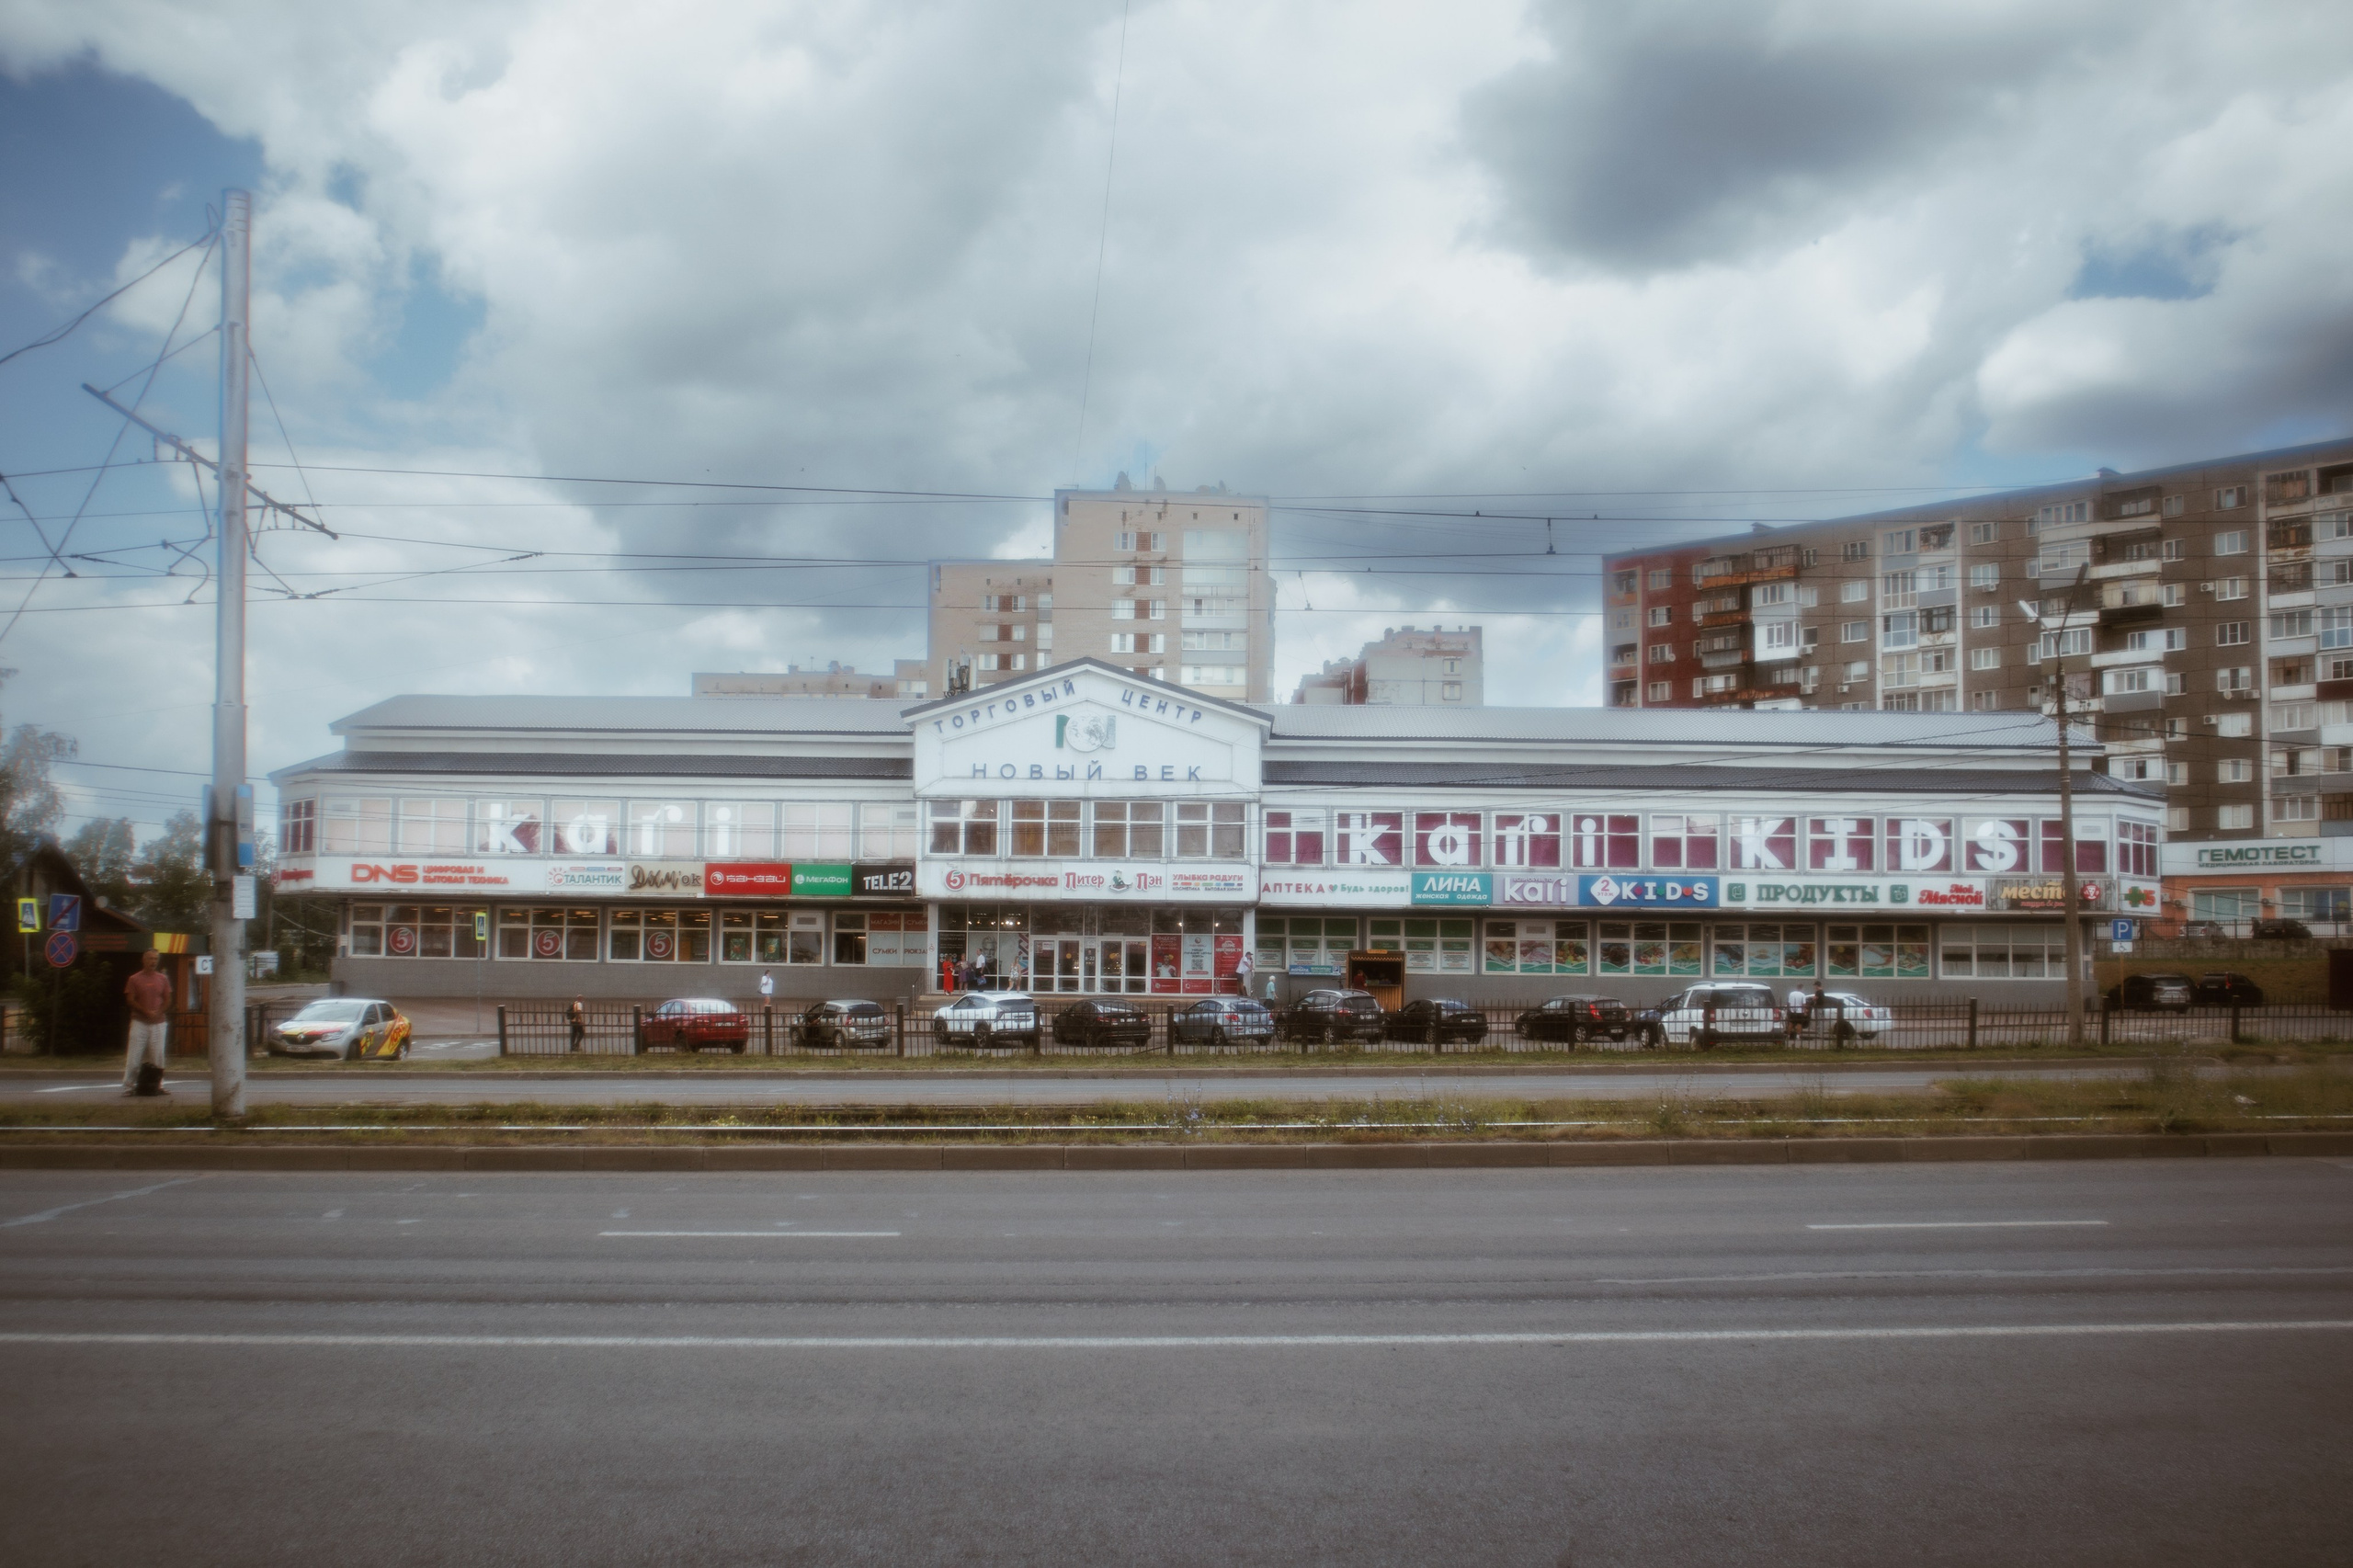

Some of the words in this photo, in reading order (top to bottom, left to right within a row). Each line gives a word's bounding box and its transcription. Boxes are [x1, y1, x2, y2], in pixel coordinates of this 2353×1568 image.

[934, 678, 1075, 734] ТОРГОВЫЙ
[1120, 689, 1202, 724] ЦЕНТР
[972, 759, 1102, 780] НОВЫЙ
[1134, 765, 1201, 781] ВЕК
[489, 802, 732, 856] kari
[1349, 813, 1597, 867] kari
[1741, 817, 2018, 871] KIDS
[2198, 846, 2322, 862] ГЕМОТЕСТ
[351, 863, 419, 883] DNS
[423, 866, 474, 874] ЦИФРОВАЯ
[563, 874, 622, 884] ТАЛАНТИК
[950, 871, 961, 884] 5
[423, 875, 465, 884] БЫТОВАЯ
[468, 876, 509, 884] ТЕХНИКА
[862, 871, 913, 891] TELE2
[970, 873, 1059, 889] Пятёрочка
[1065, 872, 1105, 889] Питер
[1136, 873, 1163, 890] Пэн
[1262, 882, 1325, 893] АПТЕКА
[1423, 877, 1482, 892] ЛИНА
[1600, 880, 1610, 892] 2
[1949, 883, 1974, 893] Мой
[1340, 884, 1365, 893] Будь
[1368, 884, 1409, 894] здоров!
[1504, 877, 1568, 902] kari
[1621, 882, 1709, 901] KIDS
[1756, 884, 1880, 903] ПРОДУКТЫ
[1918, 889, 1984, 905] Мясной
[395, 929, 408, 949] 5
[541, 932, 554, 951] 5
[654, 934, 666, 953] 5
